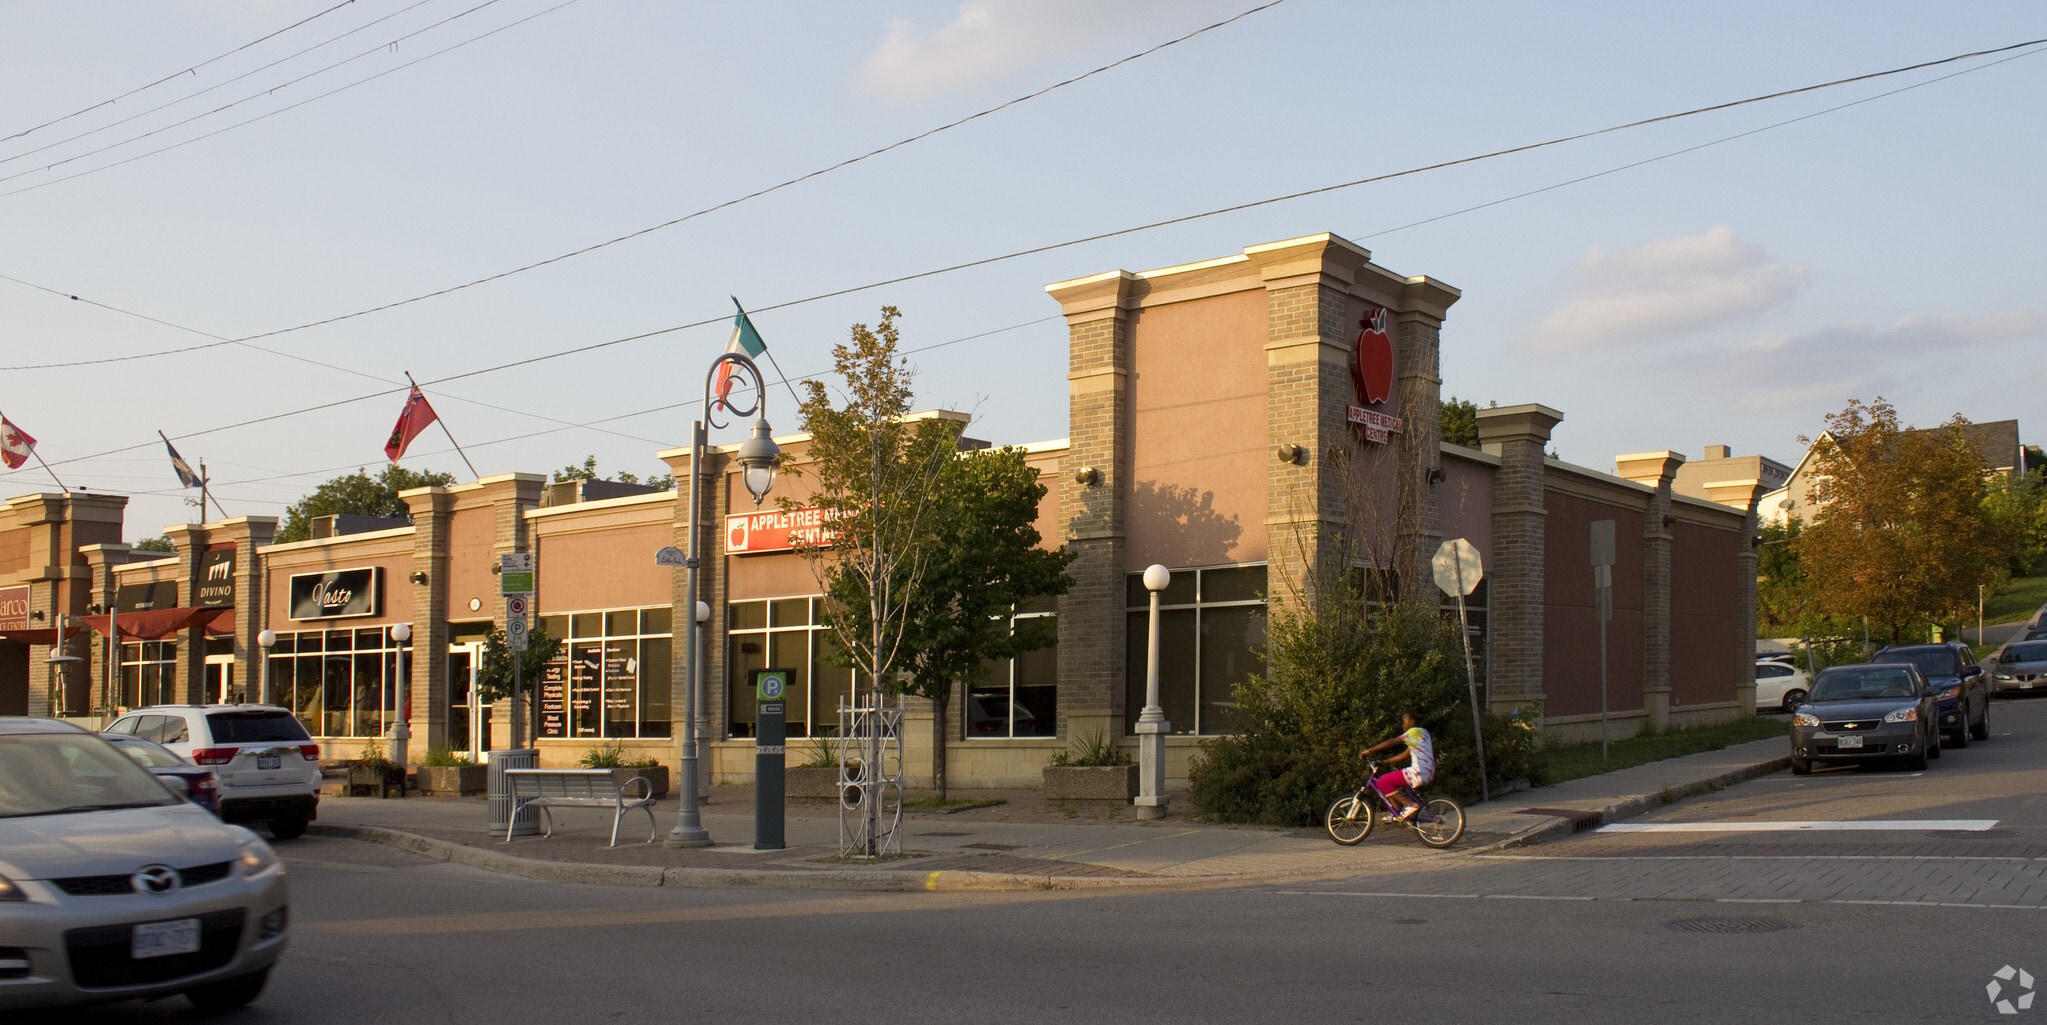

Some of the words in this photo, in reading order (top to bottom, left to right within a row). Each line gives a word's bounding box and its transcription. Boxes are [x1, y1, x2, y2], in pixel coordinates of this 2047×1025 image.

[1349, 406, 1380, 425] APPLETREE
[1381, 414, 1403, 432] MEDICAL
[1366, 426, 1387, 443] CENTRE
[751, 509, 820, 531] APPLETREE
[200, 585, 232, 598] DIVINO
[312, 580, 352, 607] Vasto
[0, 599, 28, 616] arco
[767, 680, 778, 694] P
